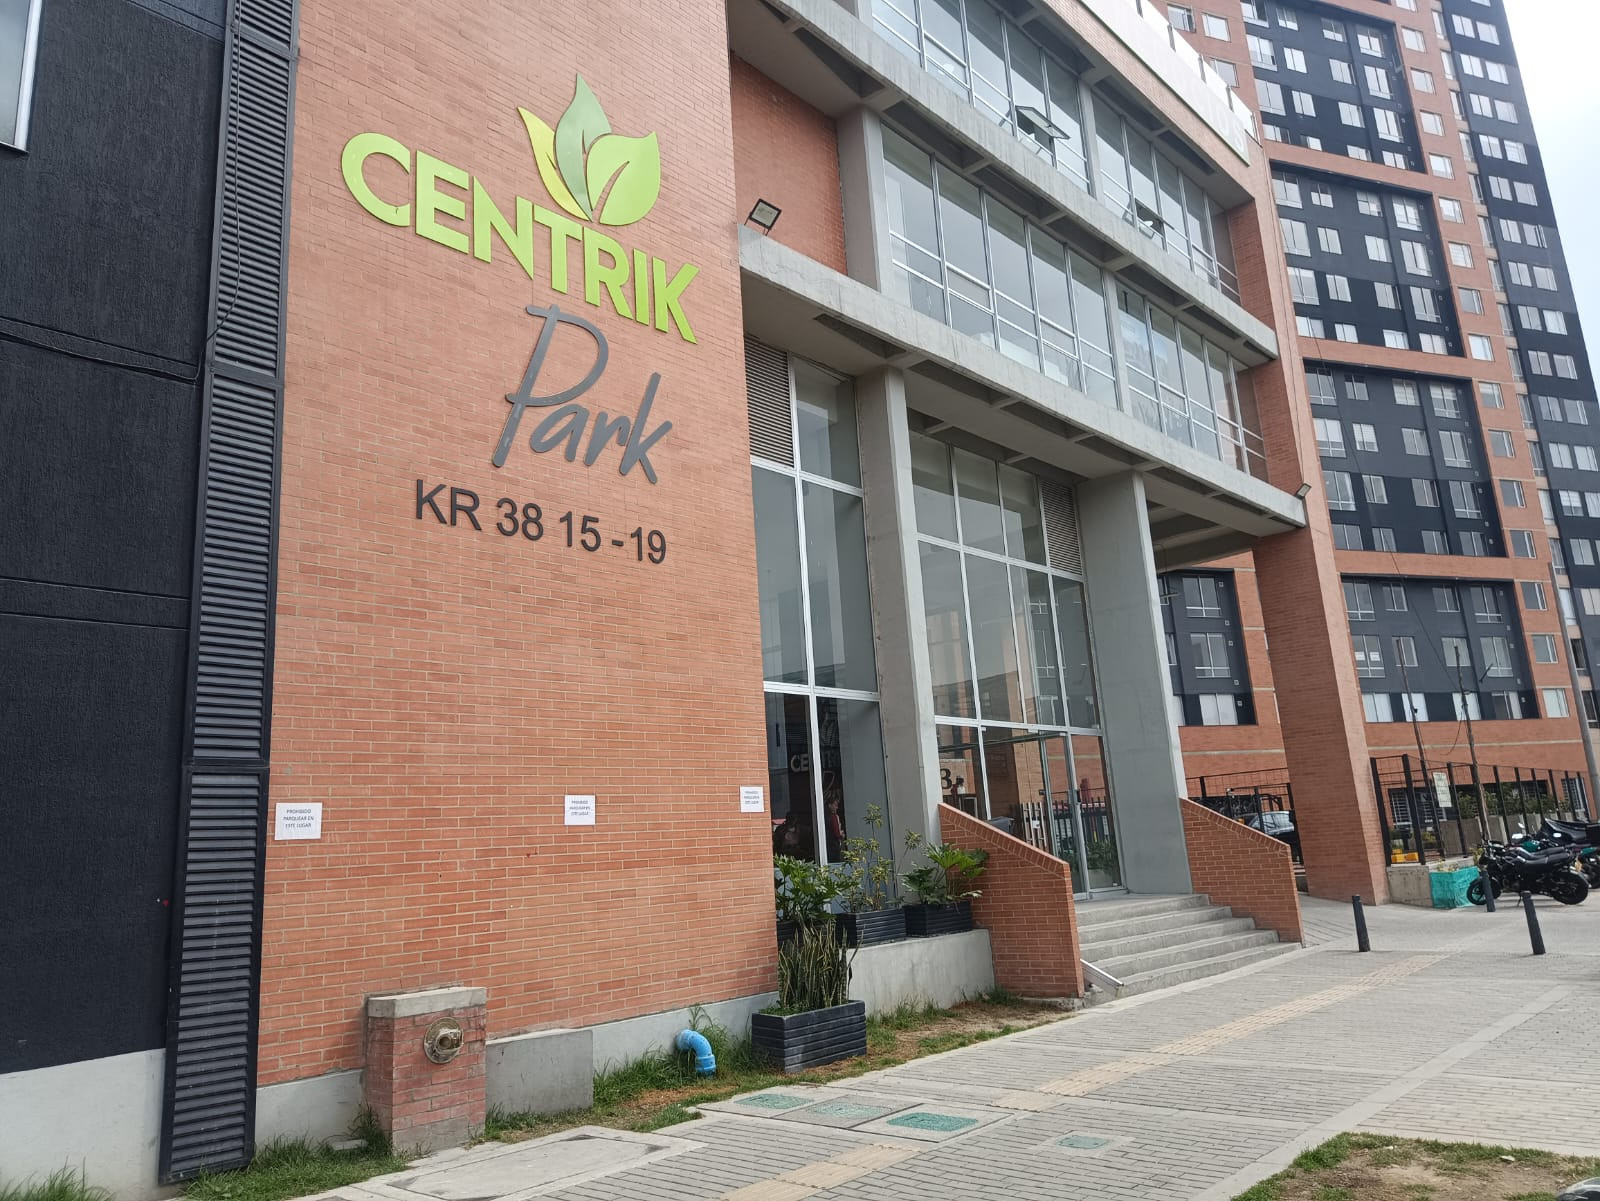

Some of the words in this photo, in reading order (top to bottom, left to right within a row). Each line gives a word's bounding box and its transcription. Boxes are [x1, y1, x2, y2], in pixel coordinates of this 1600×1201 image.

[340, 132, 700, 345] CENTRIK
[491, 303, 673, 484] Park
[415, 478, 482, 532] KR
[495, 497, 545, 542] 38
